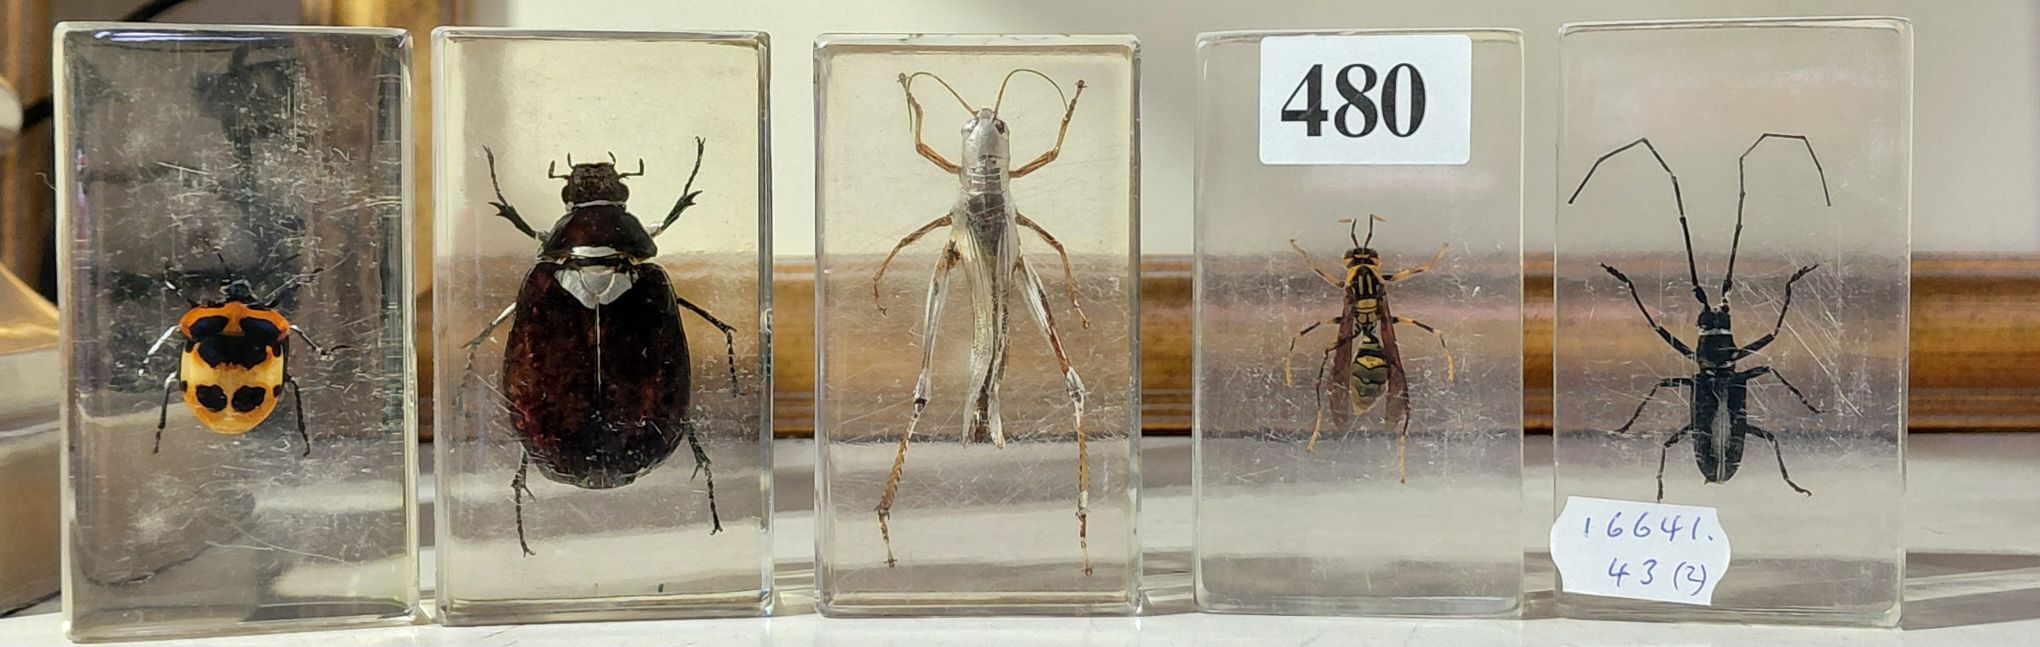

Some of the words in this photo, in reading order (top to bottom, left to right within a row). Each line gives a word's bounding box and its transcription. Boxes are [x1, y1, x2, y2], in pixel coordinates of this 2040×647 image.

[1280, 62, 1426, 138] 480
[1608, 558, 1658, 587] 43
[1673, 561, 1707, 596] (2)
